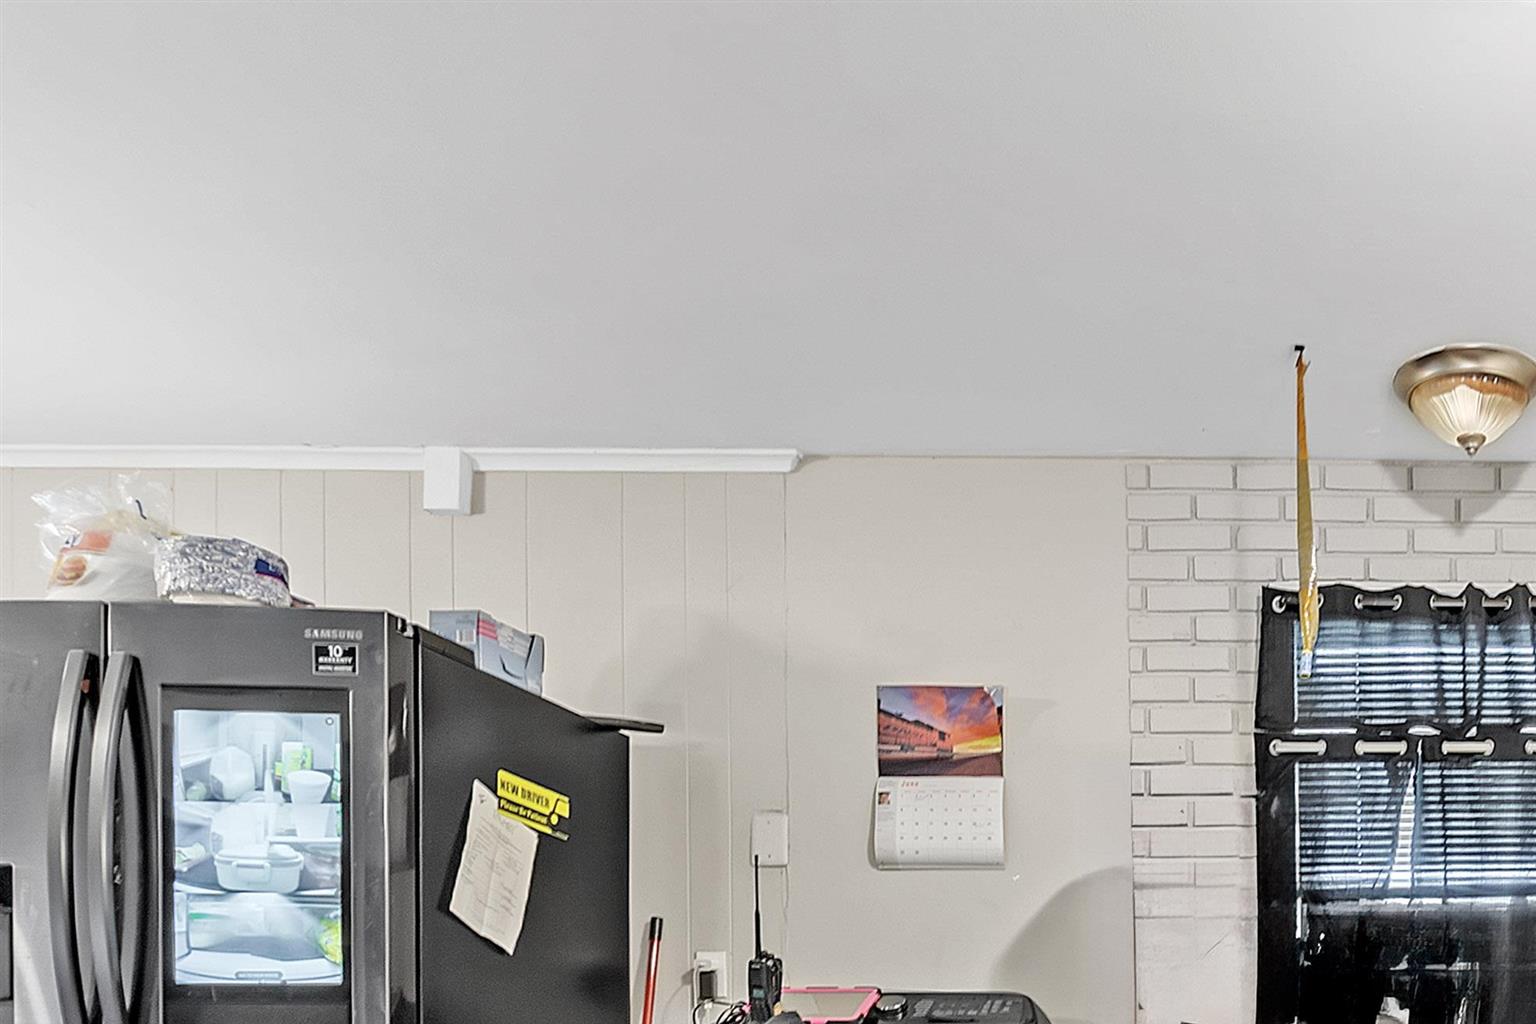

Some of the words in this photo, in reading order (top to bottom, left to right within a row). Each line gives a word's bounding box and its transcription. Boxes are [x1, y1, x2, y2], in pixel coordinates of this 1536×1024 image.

[304, 628, 363, 640] SAMSUNG
[328, 644, 343, 658] 10
[500, 778, 519, 796] NEW
[520, 787, 550, 809] DRIVER
